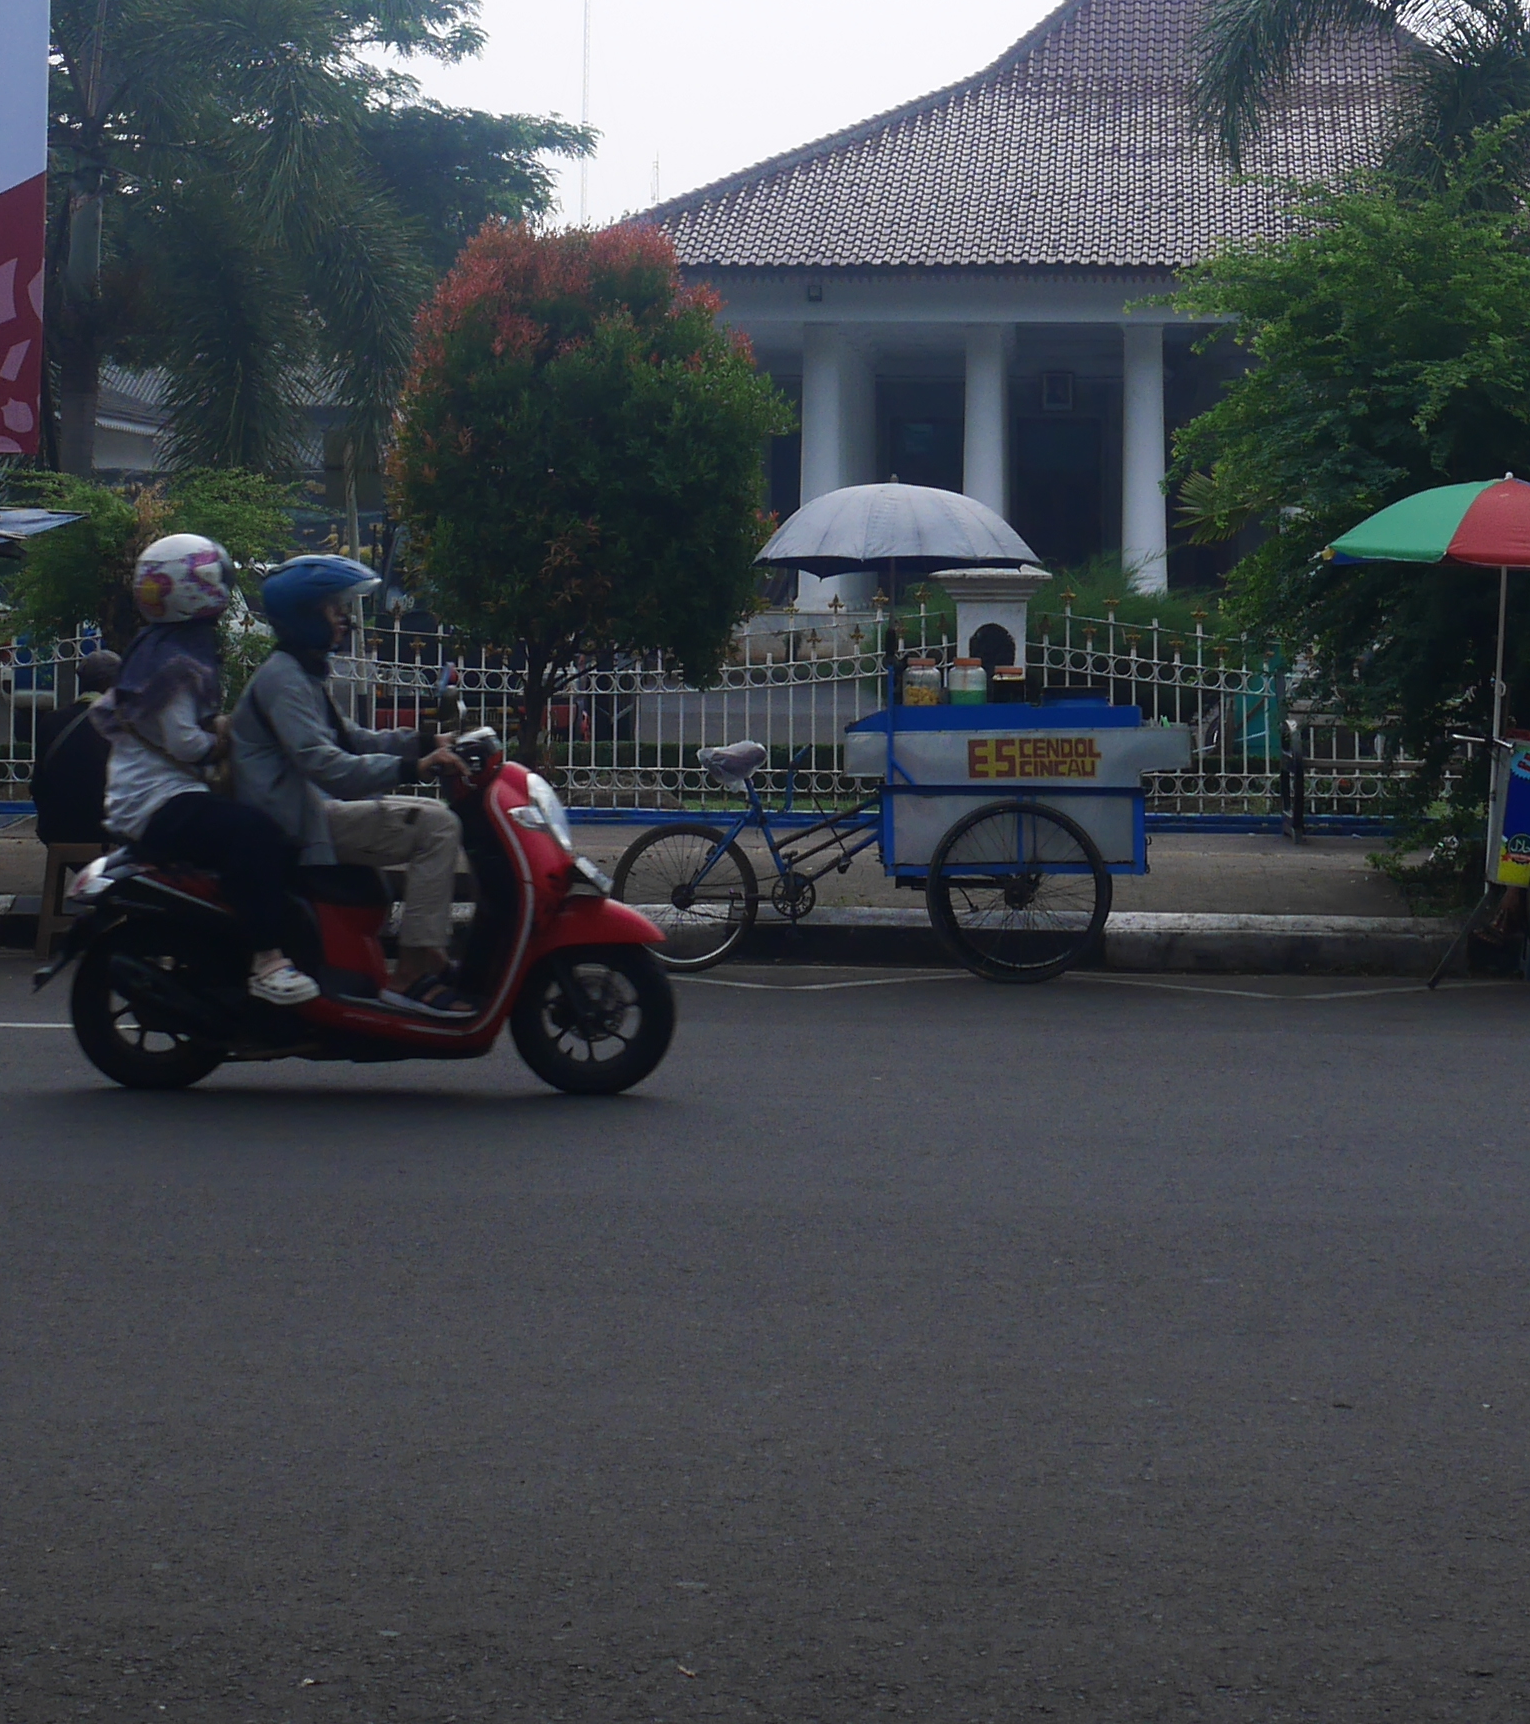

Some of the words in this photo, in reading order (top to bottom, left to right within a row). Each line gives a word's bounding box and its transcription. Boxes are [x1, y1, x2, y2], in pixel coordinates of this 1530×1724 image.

[968, 738, 1017, 778] ES
[1018, 737, 1102, 759] CENDOL
[1018, 758, 1097, 778] CINCAU
